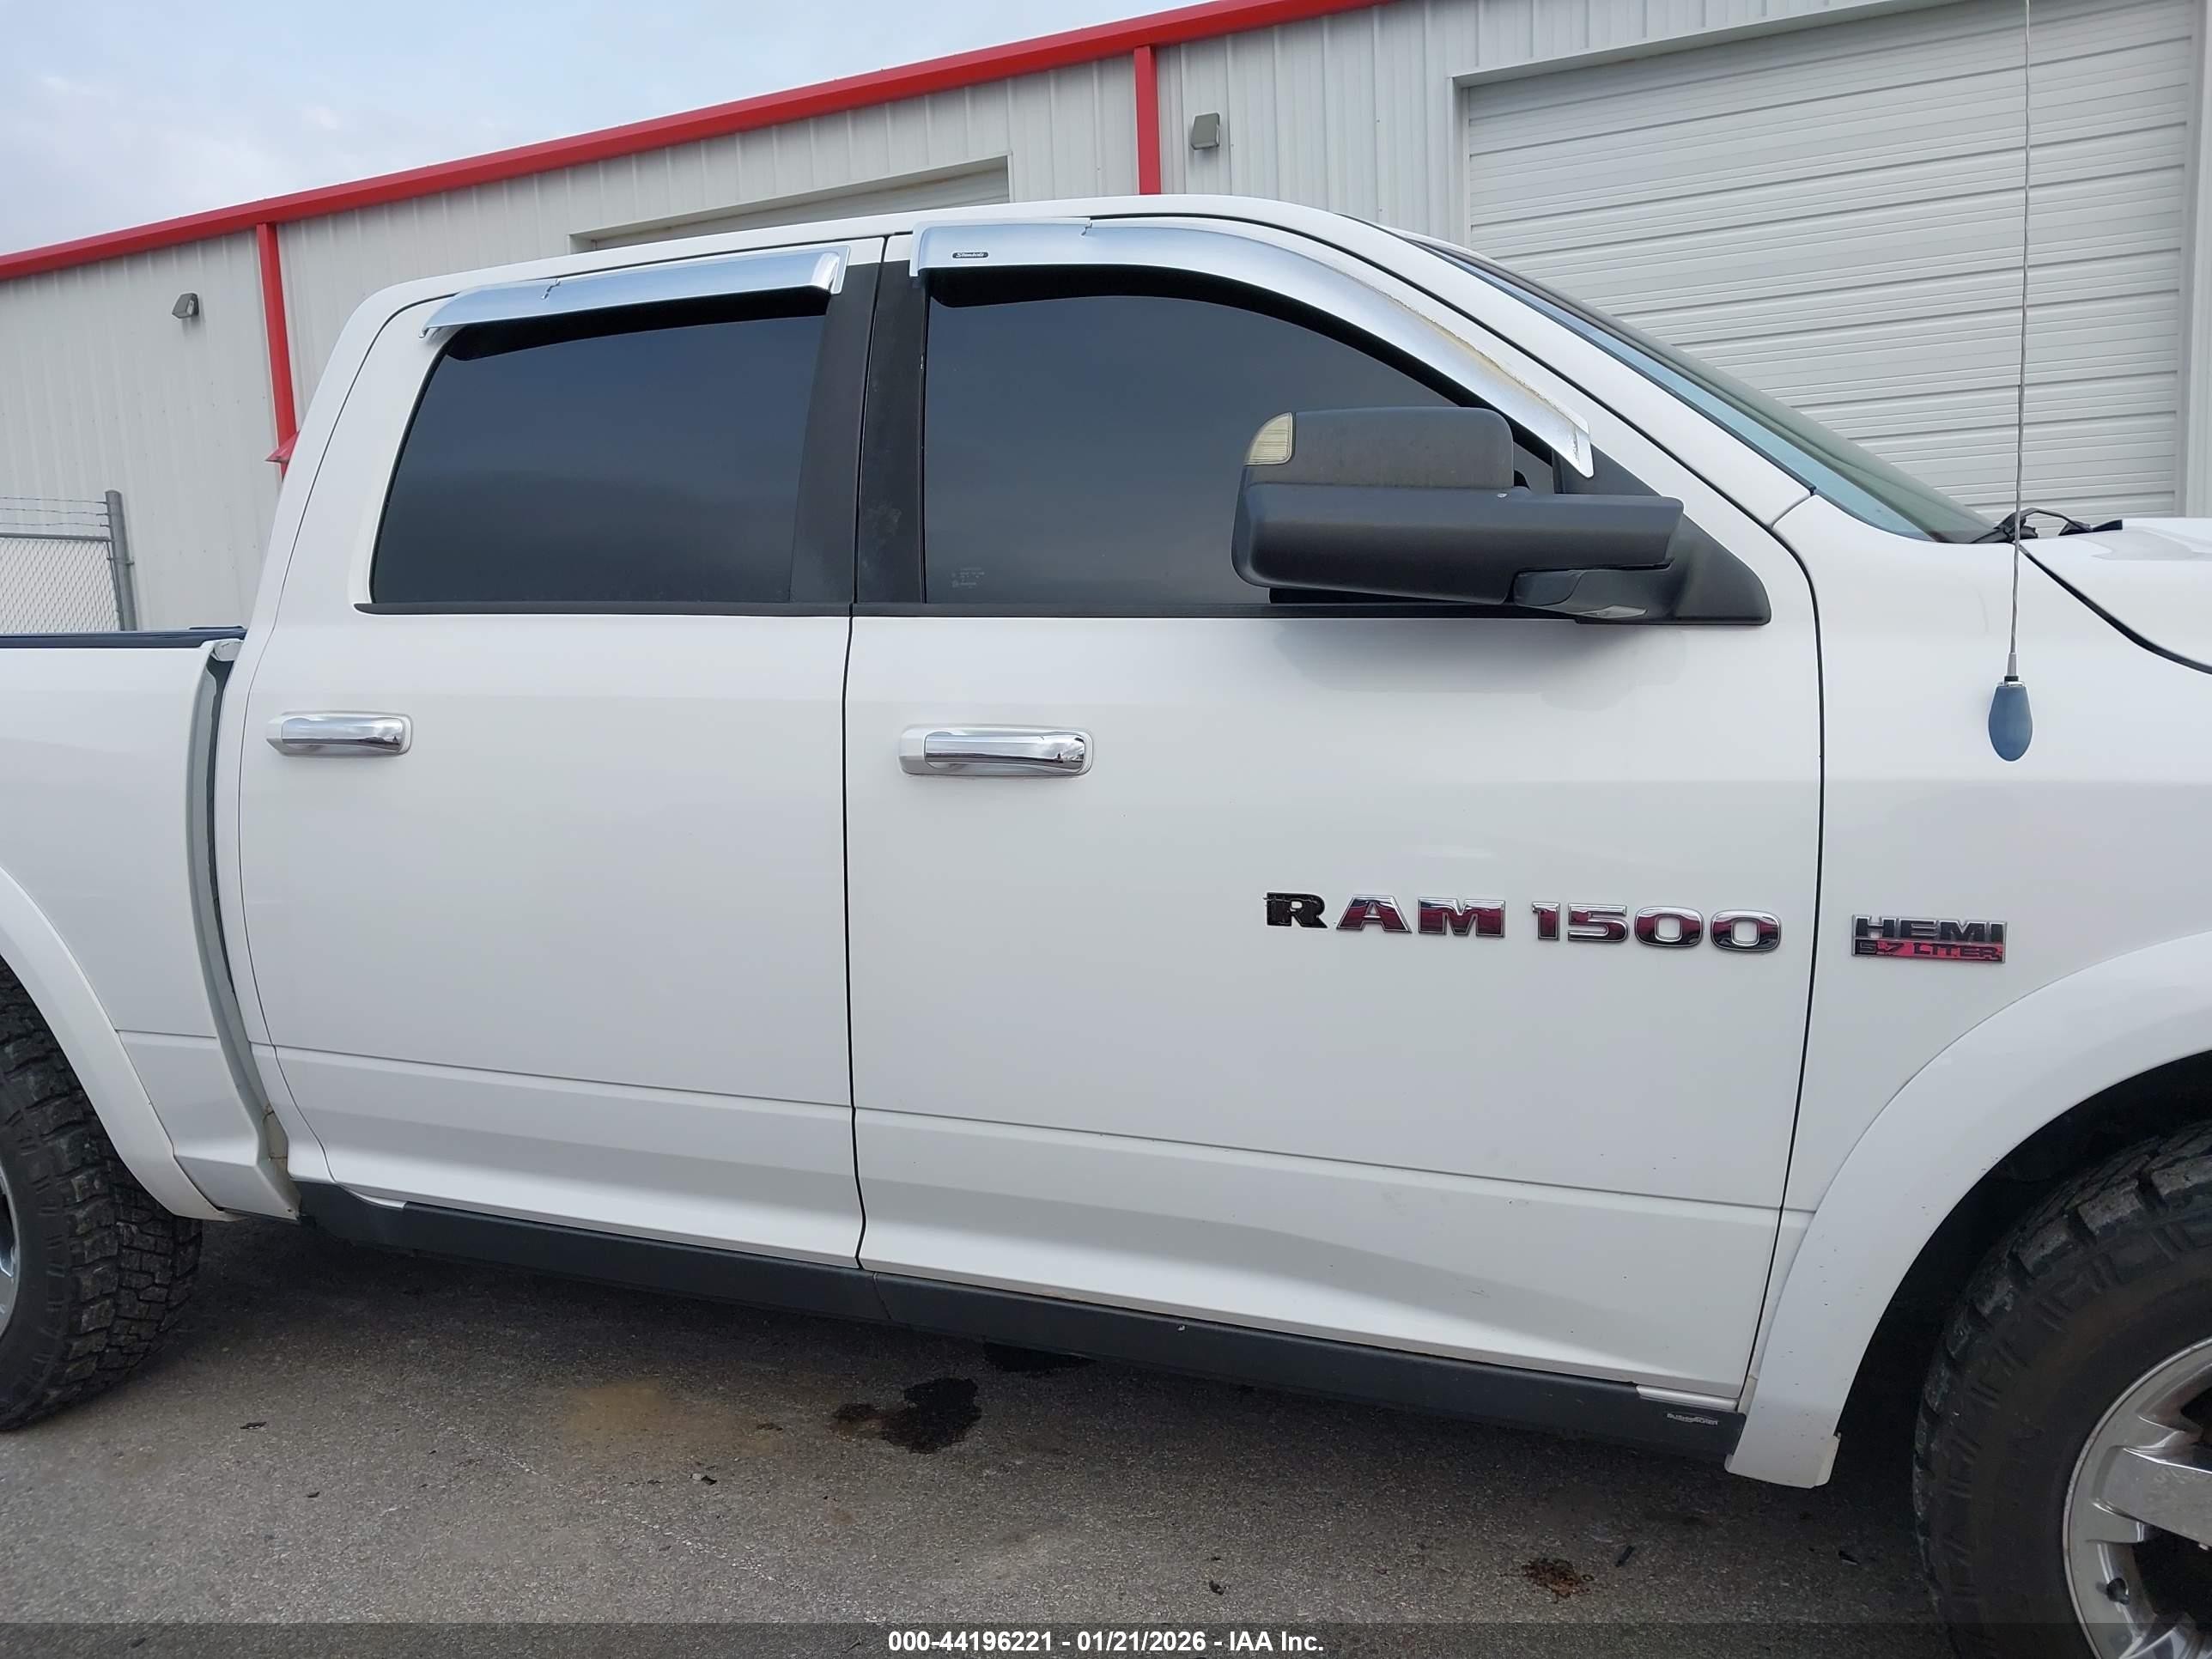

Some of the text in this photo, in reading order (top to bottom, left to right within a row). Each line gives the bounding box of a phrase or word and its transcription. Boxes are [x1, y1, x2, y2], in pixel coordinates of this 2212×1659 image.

[1265, 891, 1783, 951] RAM 1500
[1853, 915, 2006, 944] HEMI
[1913, 942, 2002, 960] LITER
